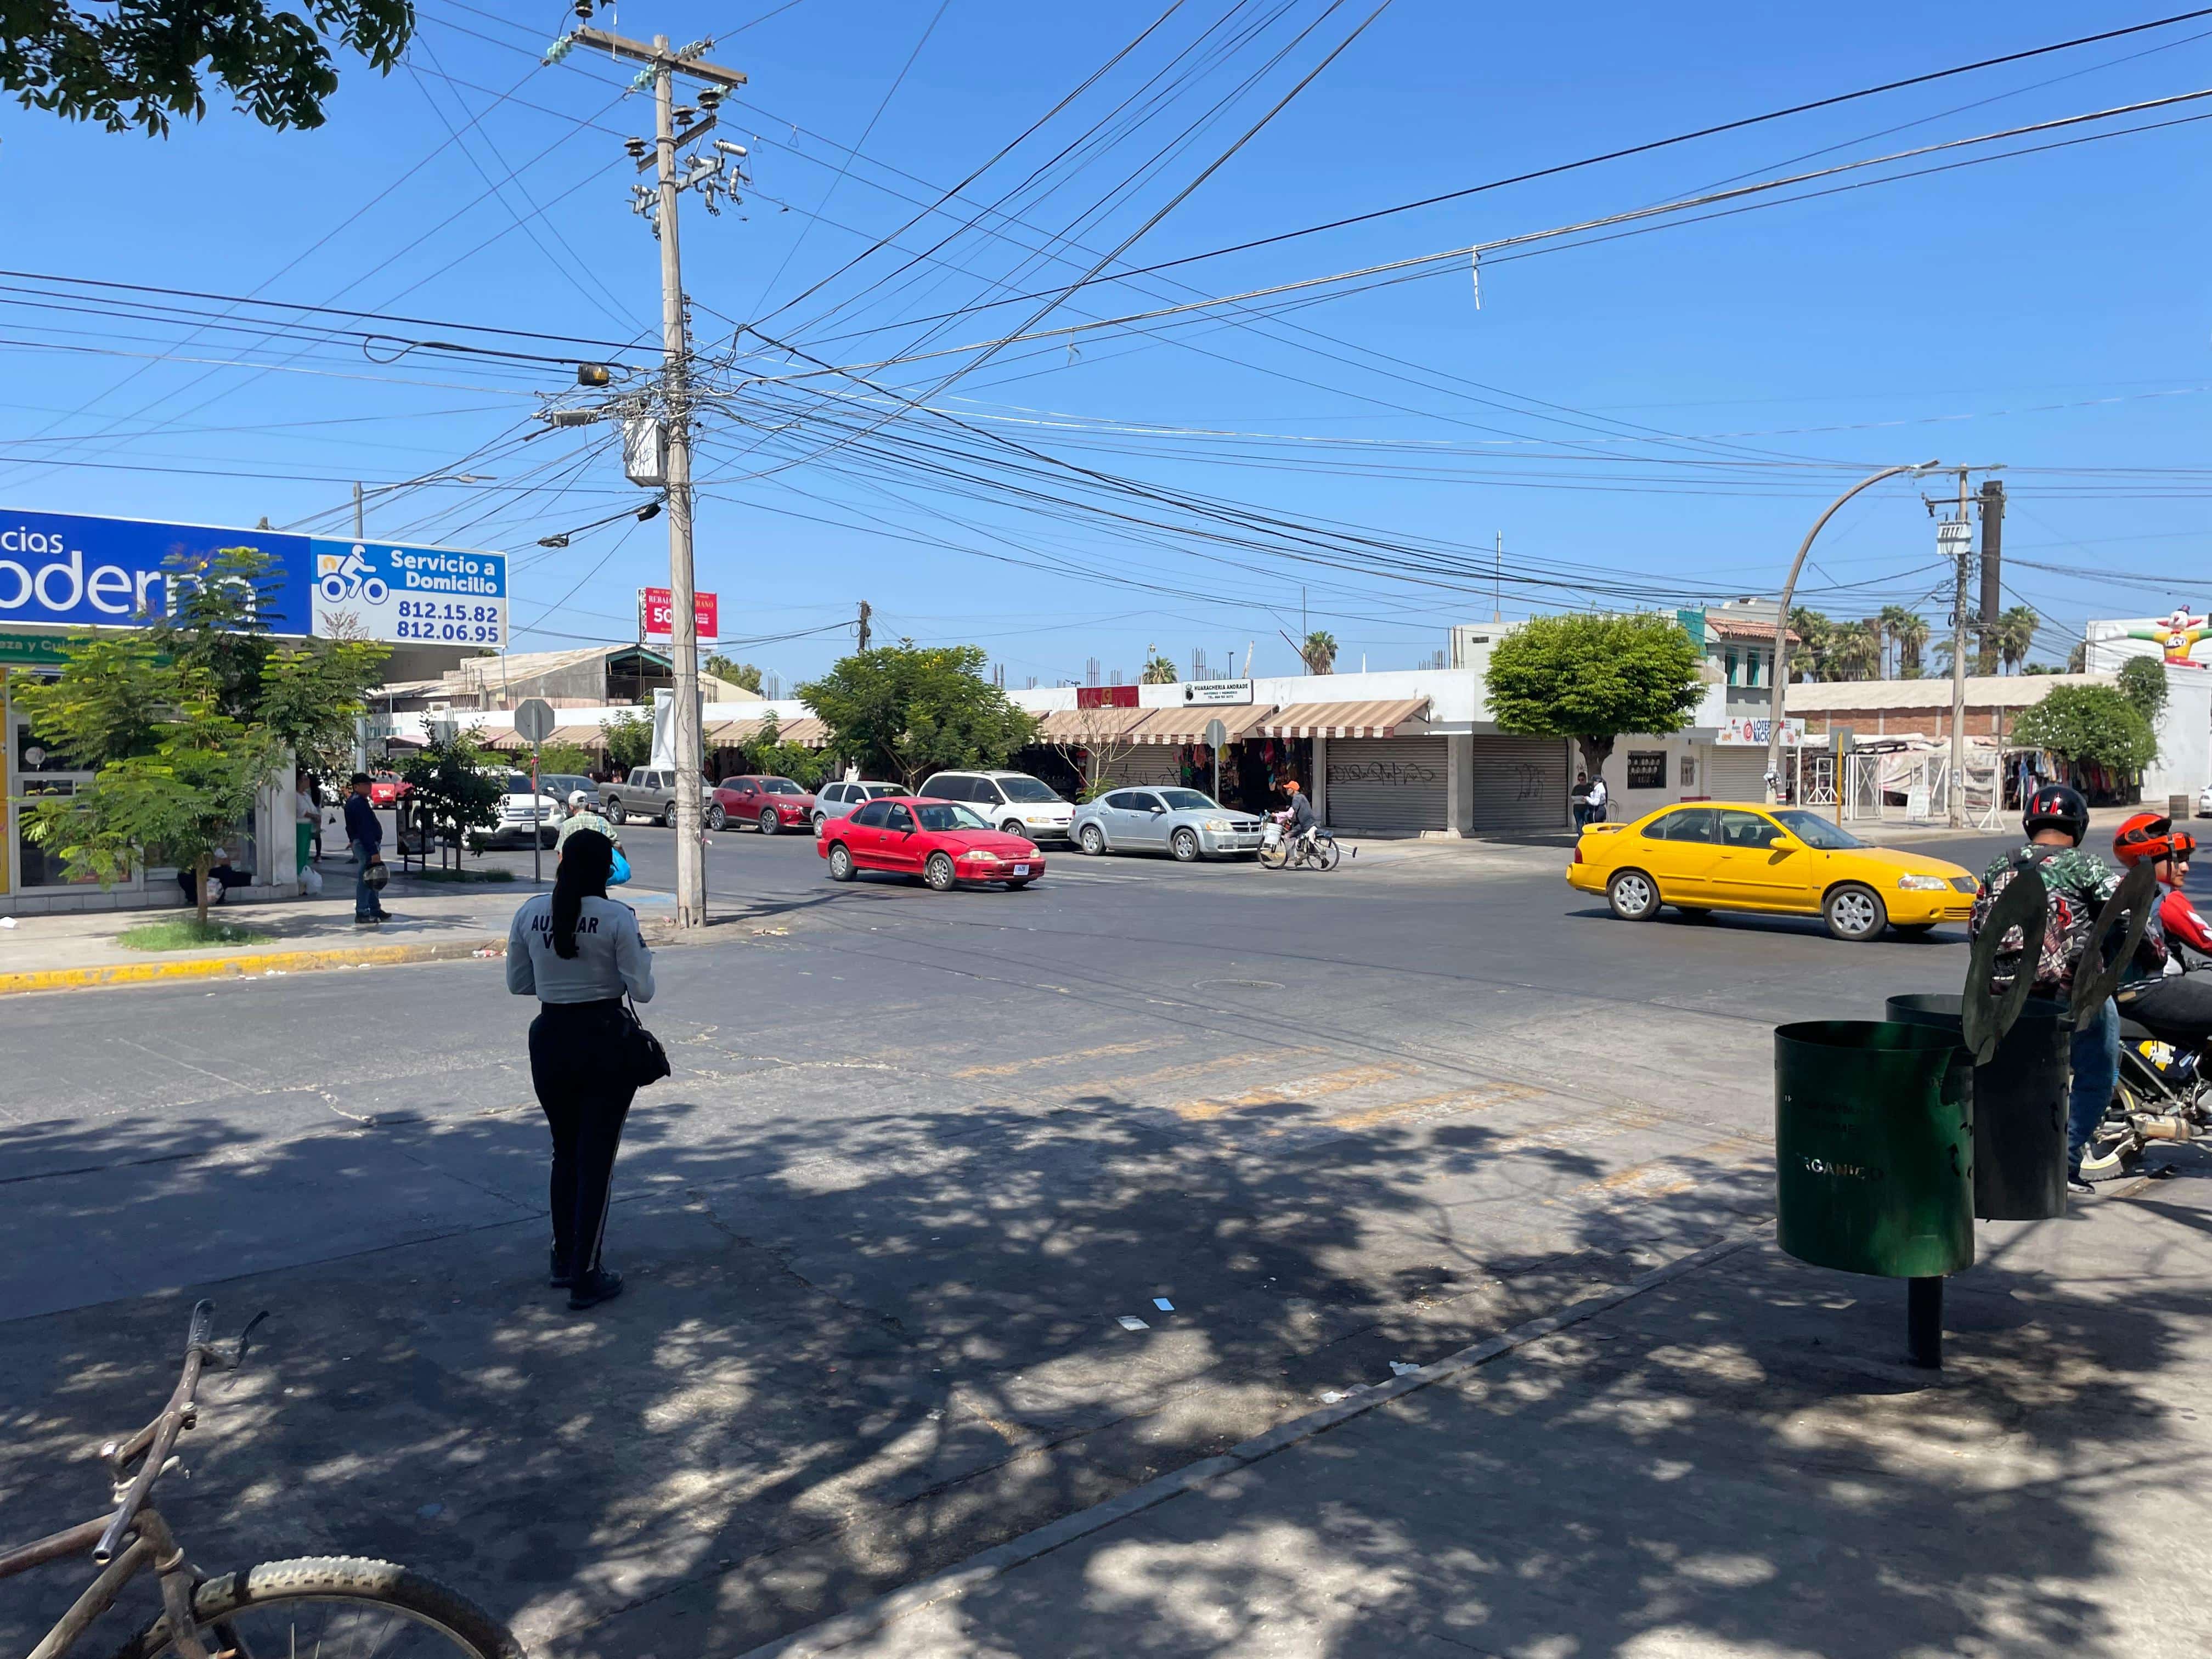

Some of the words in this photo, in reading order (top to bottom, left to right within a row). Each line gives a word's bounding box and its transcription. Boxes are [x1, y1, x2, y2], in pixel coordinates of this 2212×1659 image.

[1, 527, 64, 554] cias
[390, 550, 479, 575] Servicio
[484, 562, 495, 575] a
[406, 571, 498, 594] Domicilio
[399, 601, 498, 623] 812.15.82
[397, 620, 499, 642] 812.06.95
